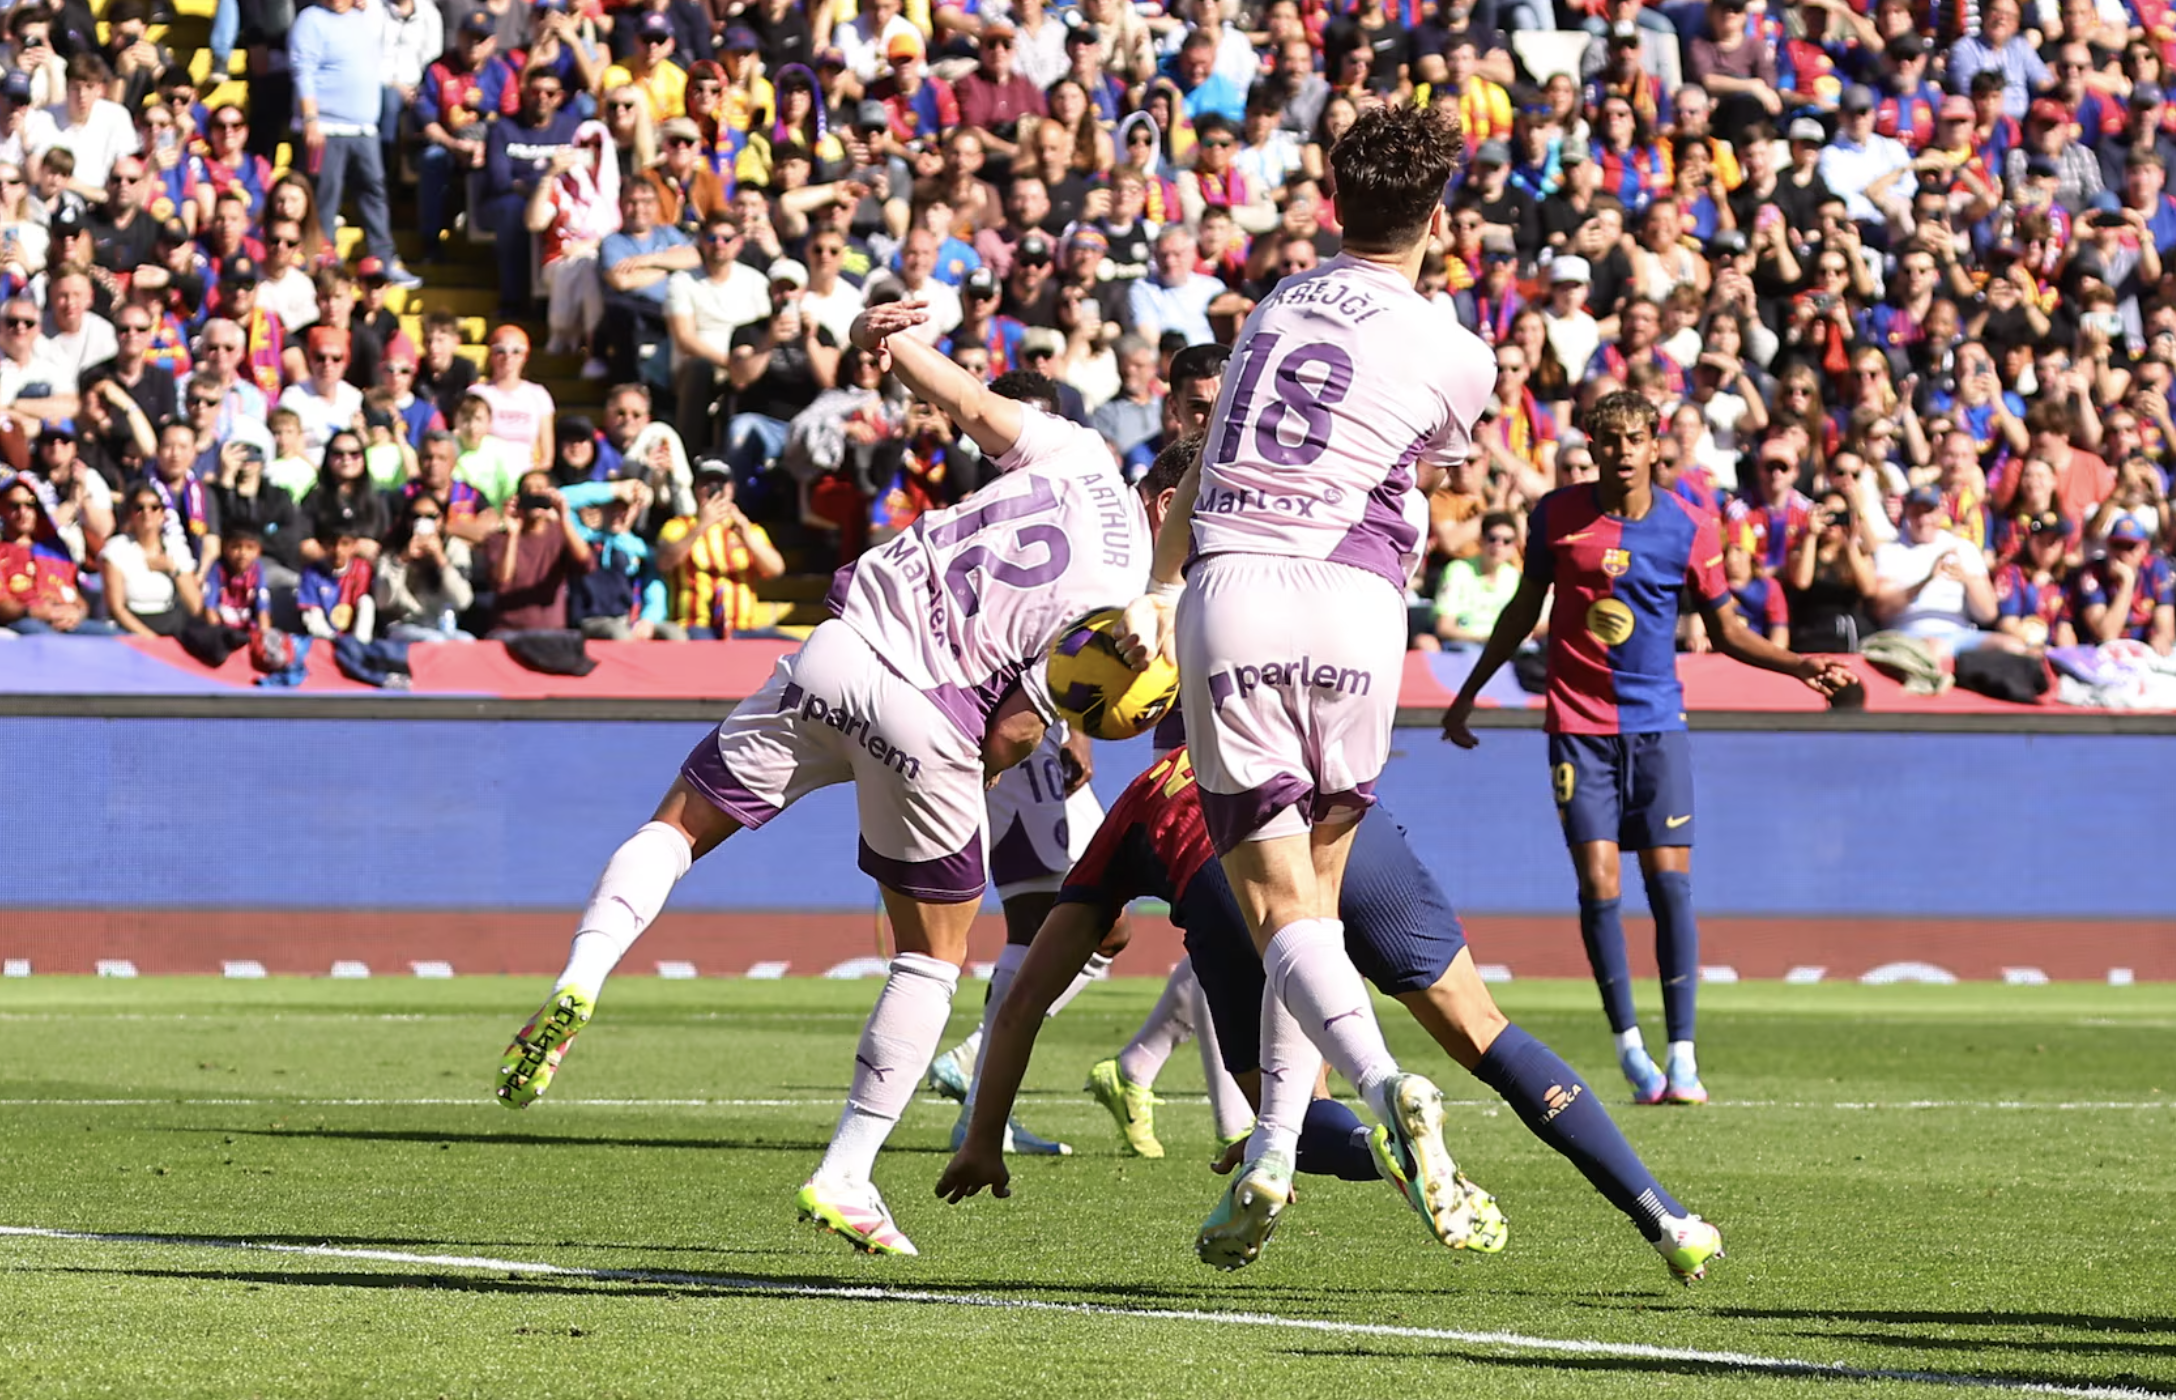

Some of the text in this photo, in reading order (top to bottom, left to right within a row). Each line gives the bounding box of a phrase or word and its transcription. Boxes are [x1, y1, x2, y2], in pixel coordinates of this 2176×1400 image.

[1218, 332, 1354, 466] 18
[927, 473, 1069, 619] 12
[1075, 472, 1130, 569] ARTHUR
[1235, 655, 1372, 699] parlem
[801, 693, 920, 779] parlem
[1019, 758, 1064, 804] 10
[1551, 761, 1575, 803] 9
[500, 994, 583, 1102] PREDATOR
